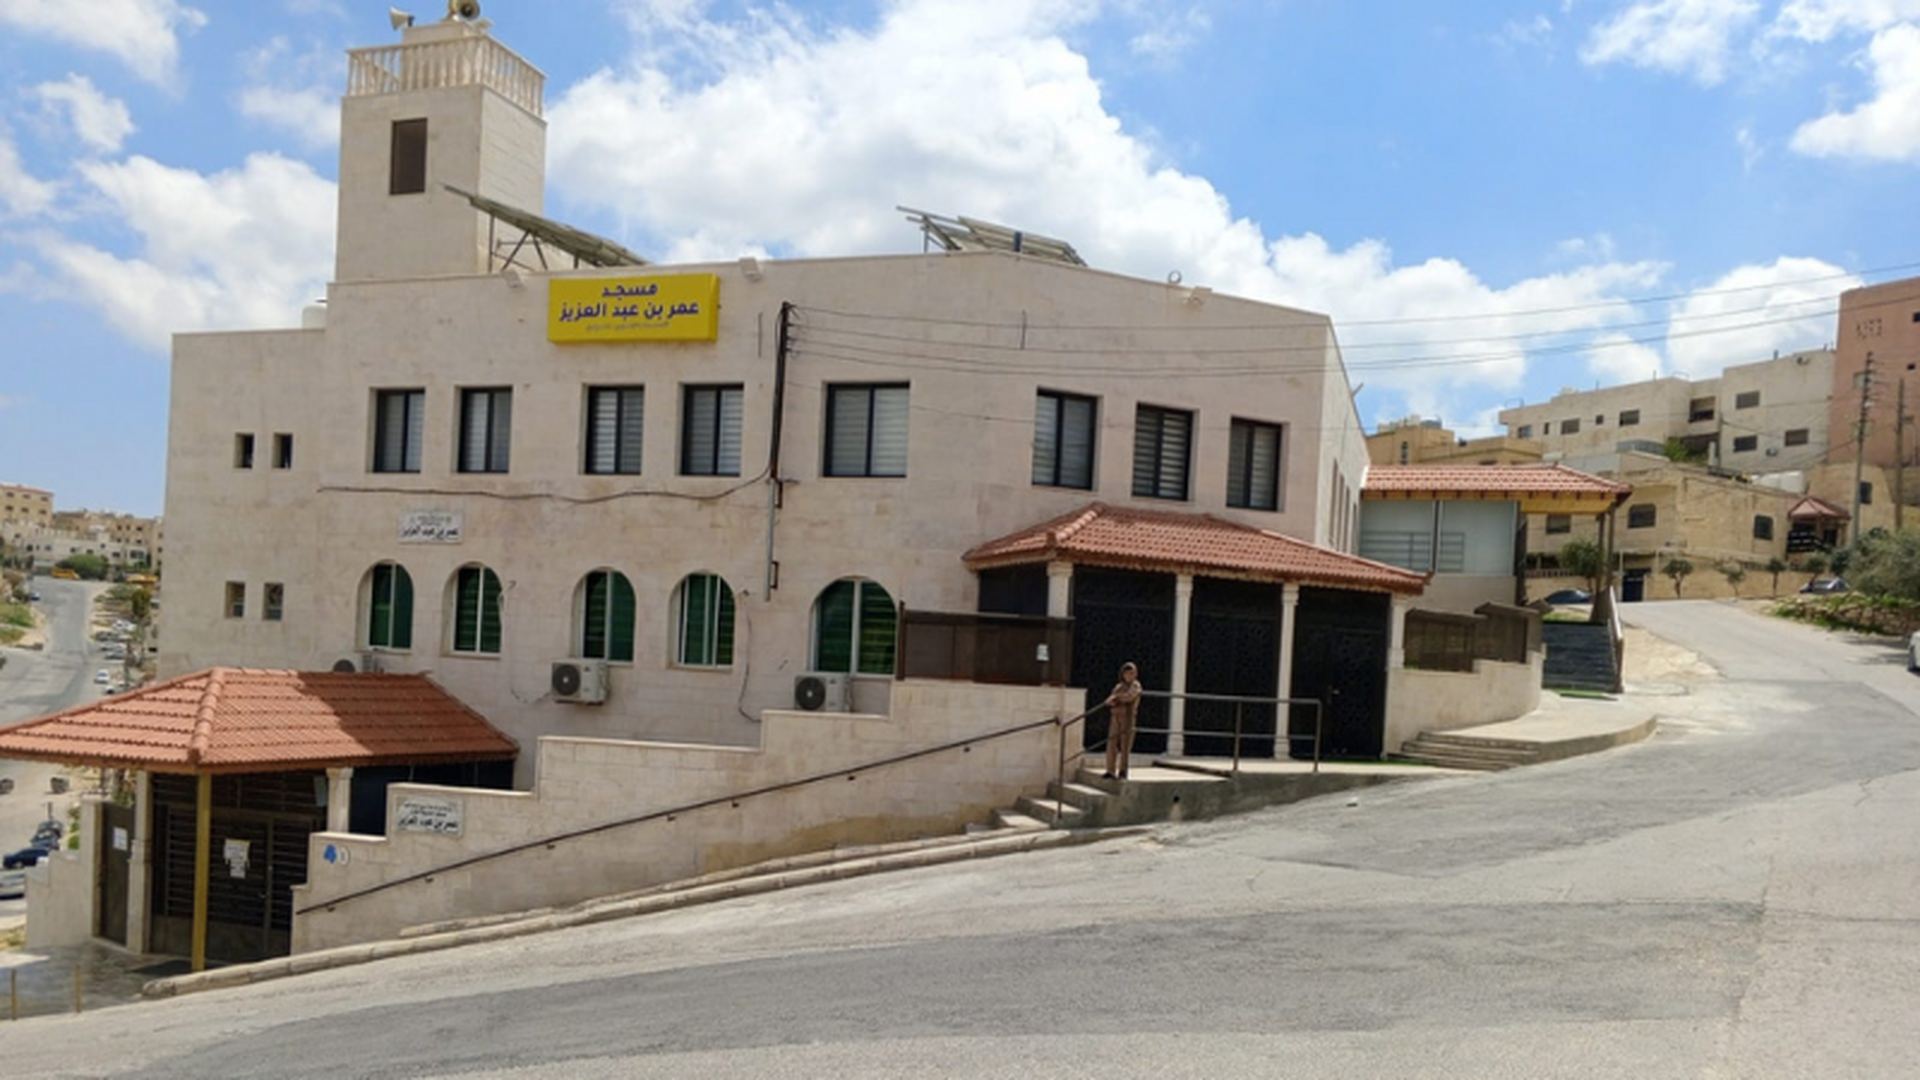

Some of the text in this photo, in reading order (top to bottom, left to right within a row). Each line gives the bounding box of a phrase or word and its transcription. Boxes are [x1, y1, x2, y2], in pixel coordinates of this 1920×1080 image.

[602, 284, 658, 300] مسجد
[559, 302, 700, 323] عمر بن عبد العزيز
